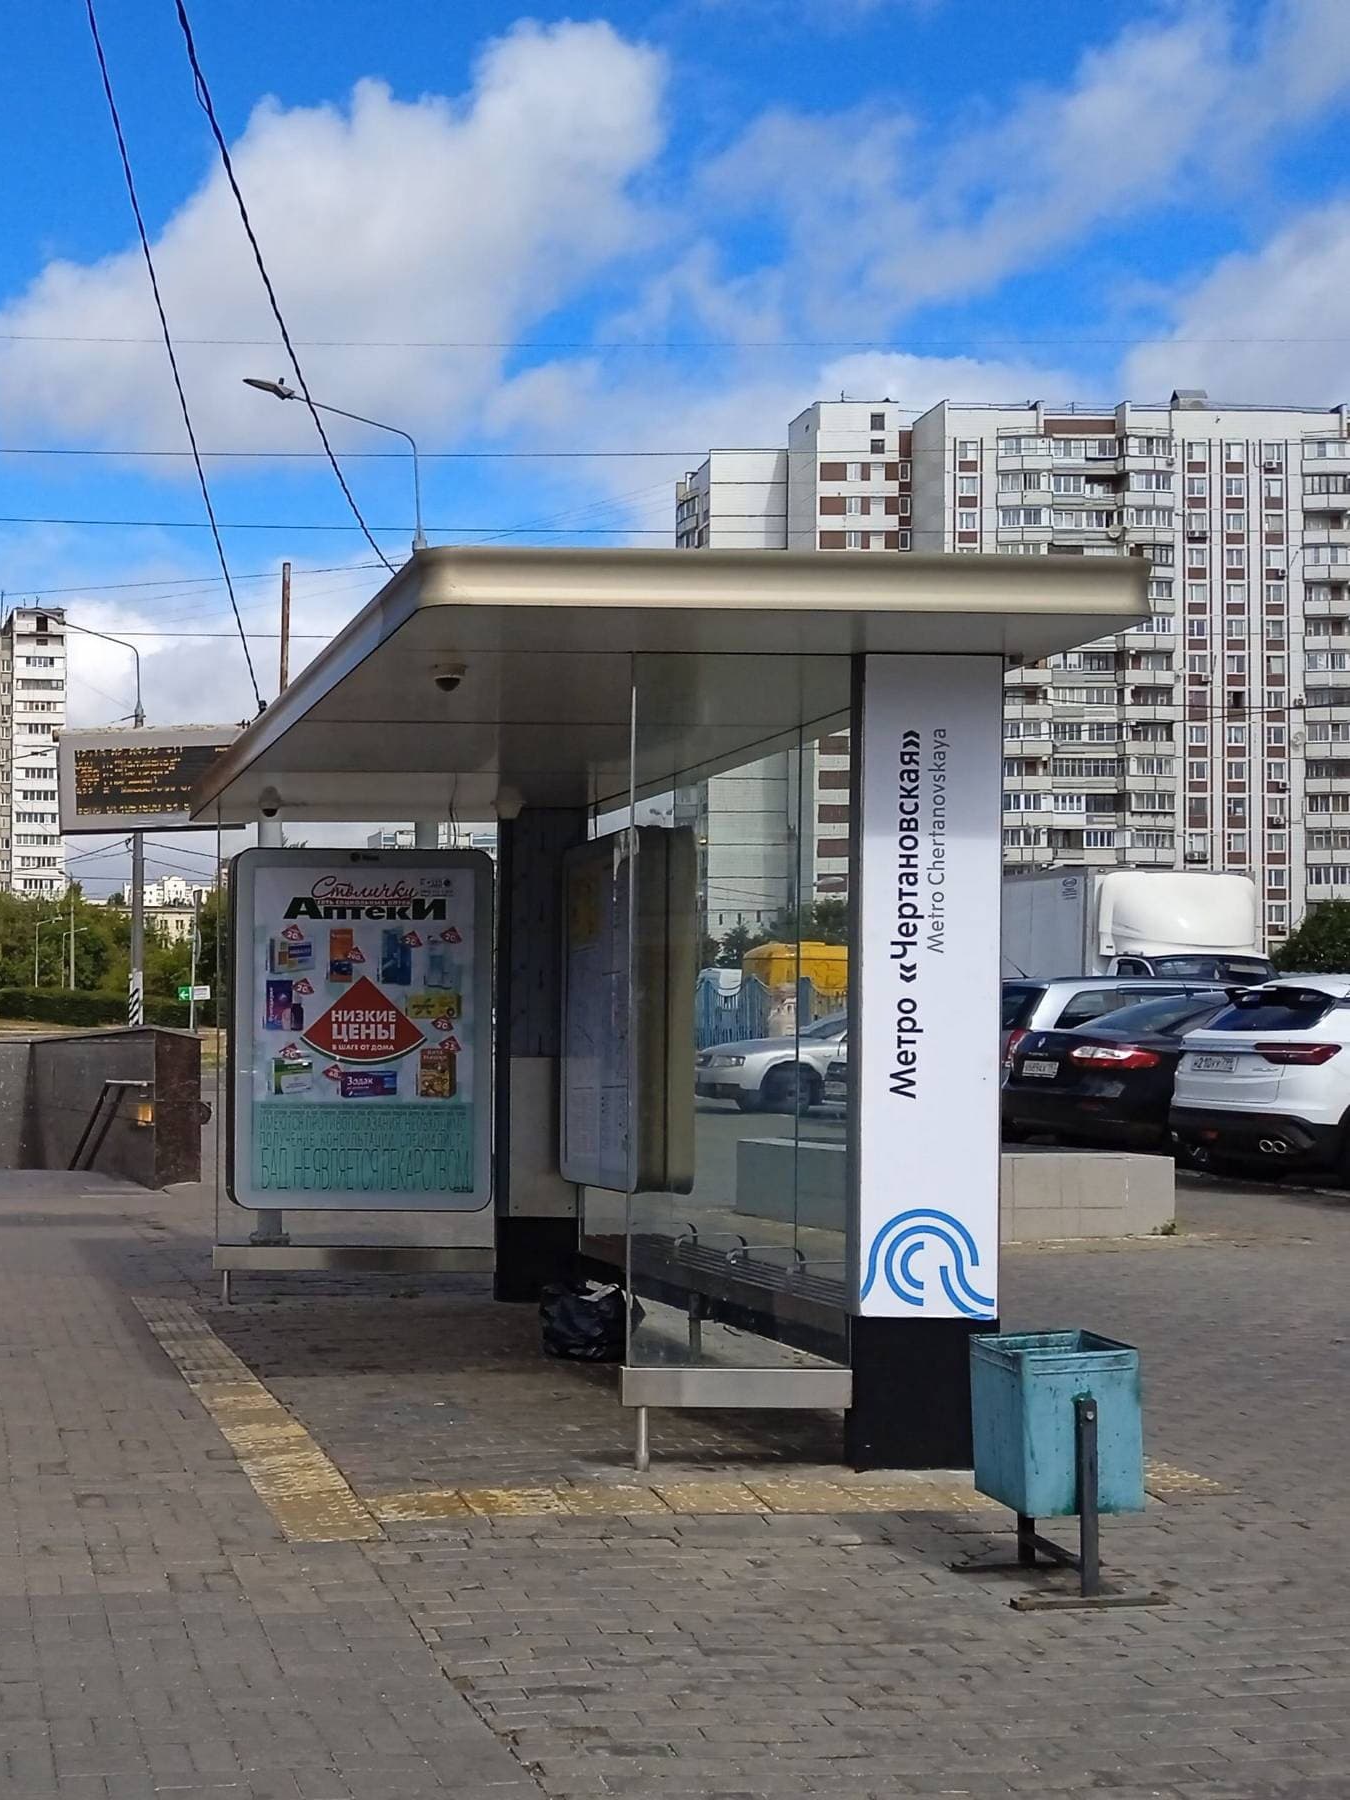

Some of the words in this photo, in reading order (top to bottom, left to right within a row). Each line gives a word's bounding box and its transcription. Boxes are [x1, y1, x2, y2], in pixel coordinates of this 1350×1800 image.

[926, 728, 951, 886] Chertanovskaya
[311, 875, 418, 899] Столички
[889, 729, 925, 983] «Чертановская»
[926, 891, 945, 954] Metro
[331, 1010, 397, 1023] НИЗКИЕ
[331, 1023, 396, 1042] ЦЕНЫ
[889, 997, 924, 1100] Метро
